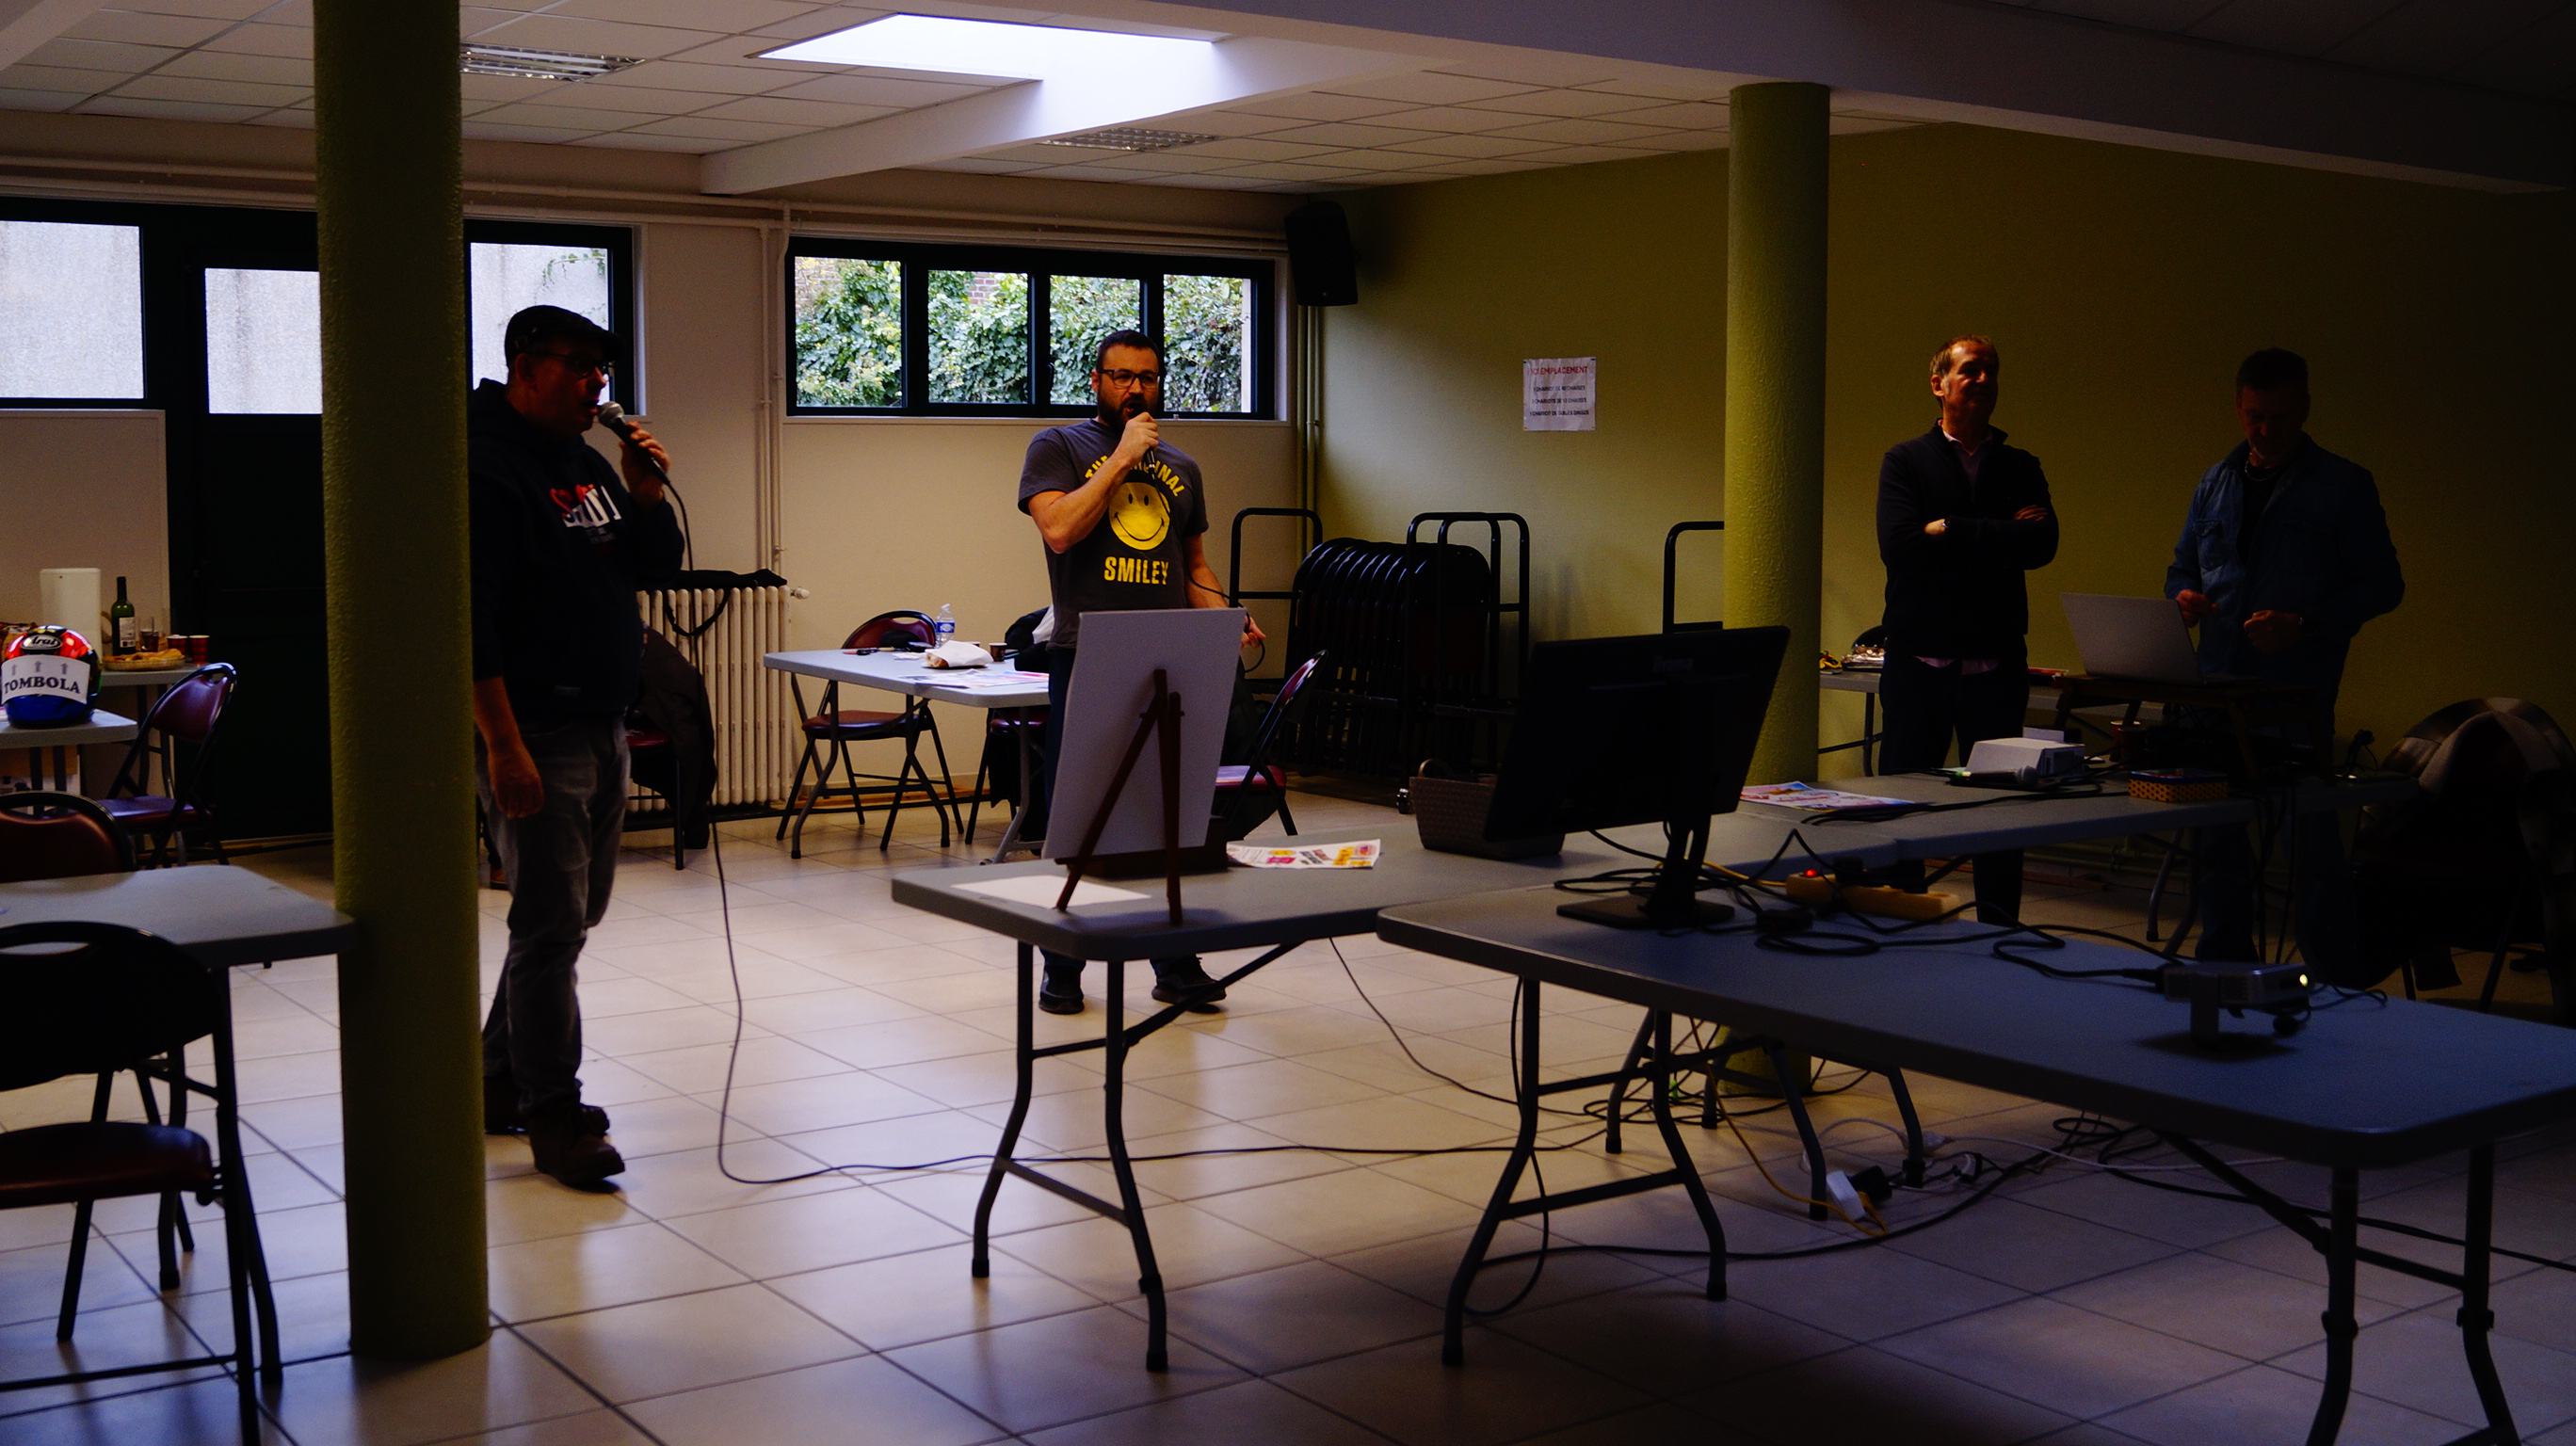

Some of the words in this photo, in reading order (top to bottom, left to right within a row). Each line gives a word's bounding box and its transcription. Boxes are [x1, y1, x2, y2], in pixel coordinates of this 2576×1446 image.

[1540, 365, 1588, 376] EMPLACEMENT
[1103, 555, 1169, 586] SMILEY
[5, 676, 80, 694] TOMBOLA
